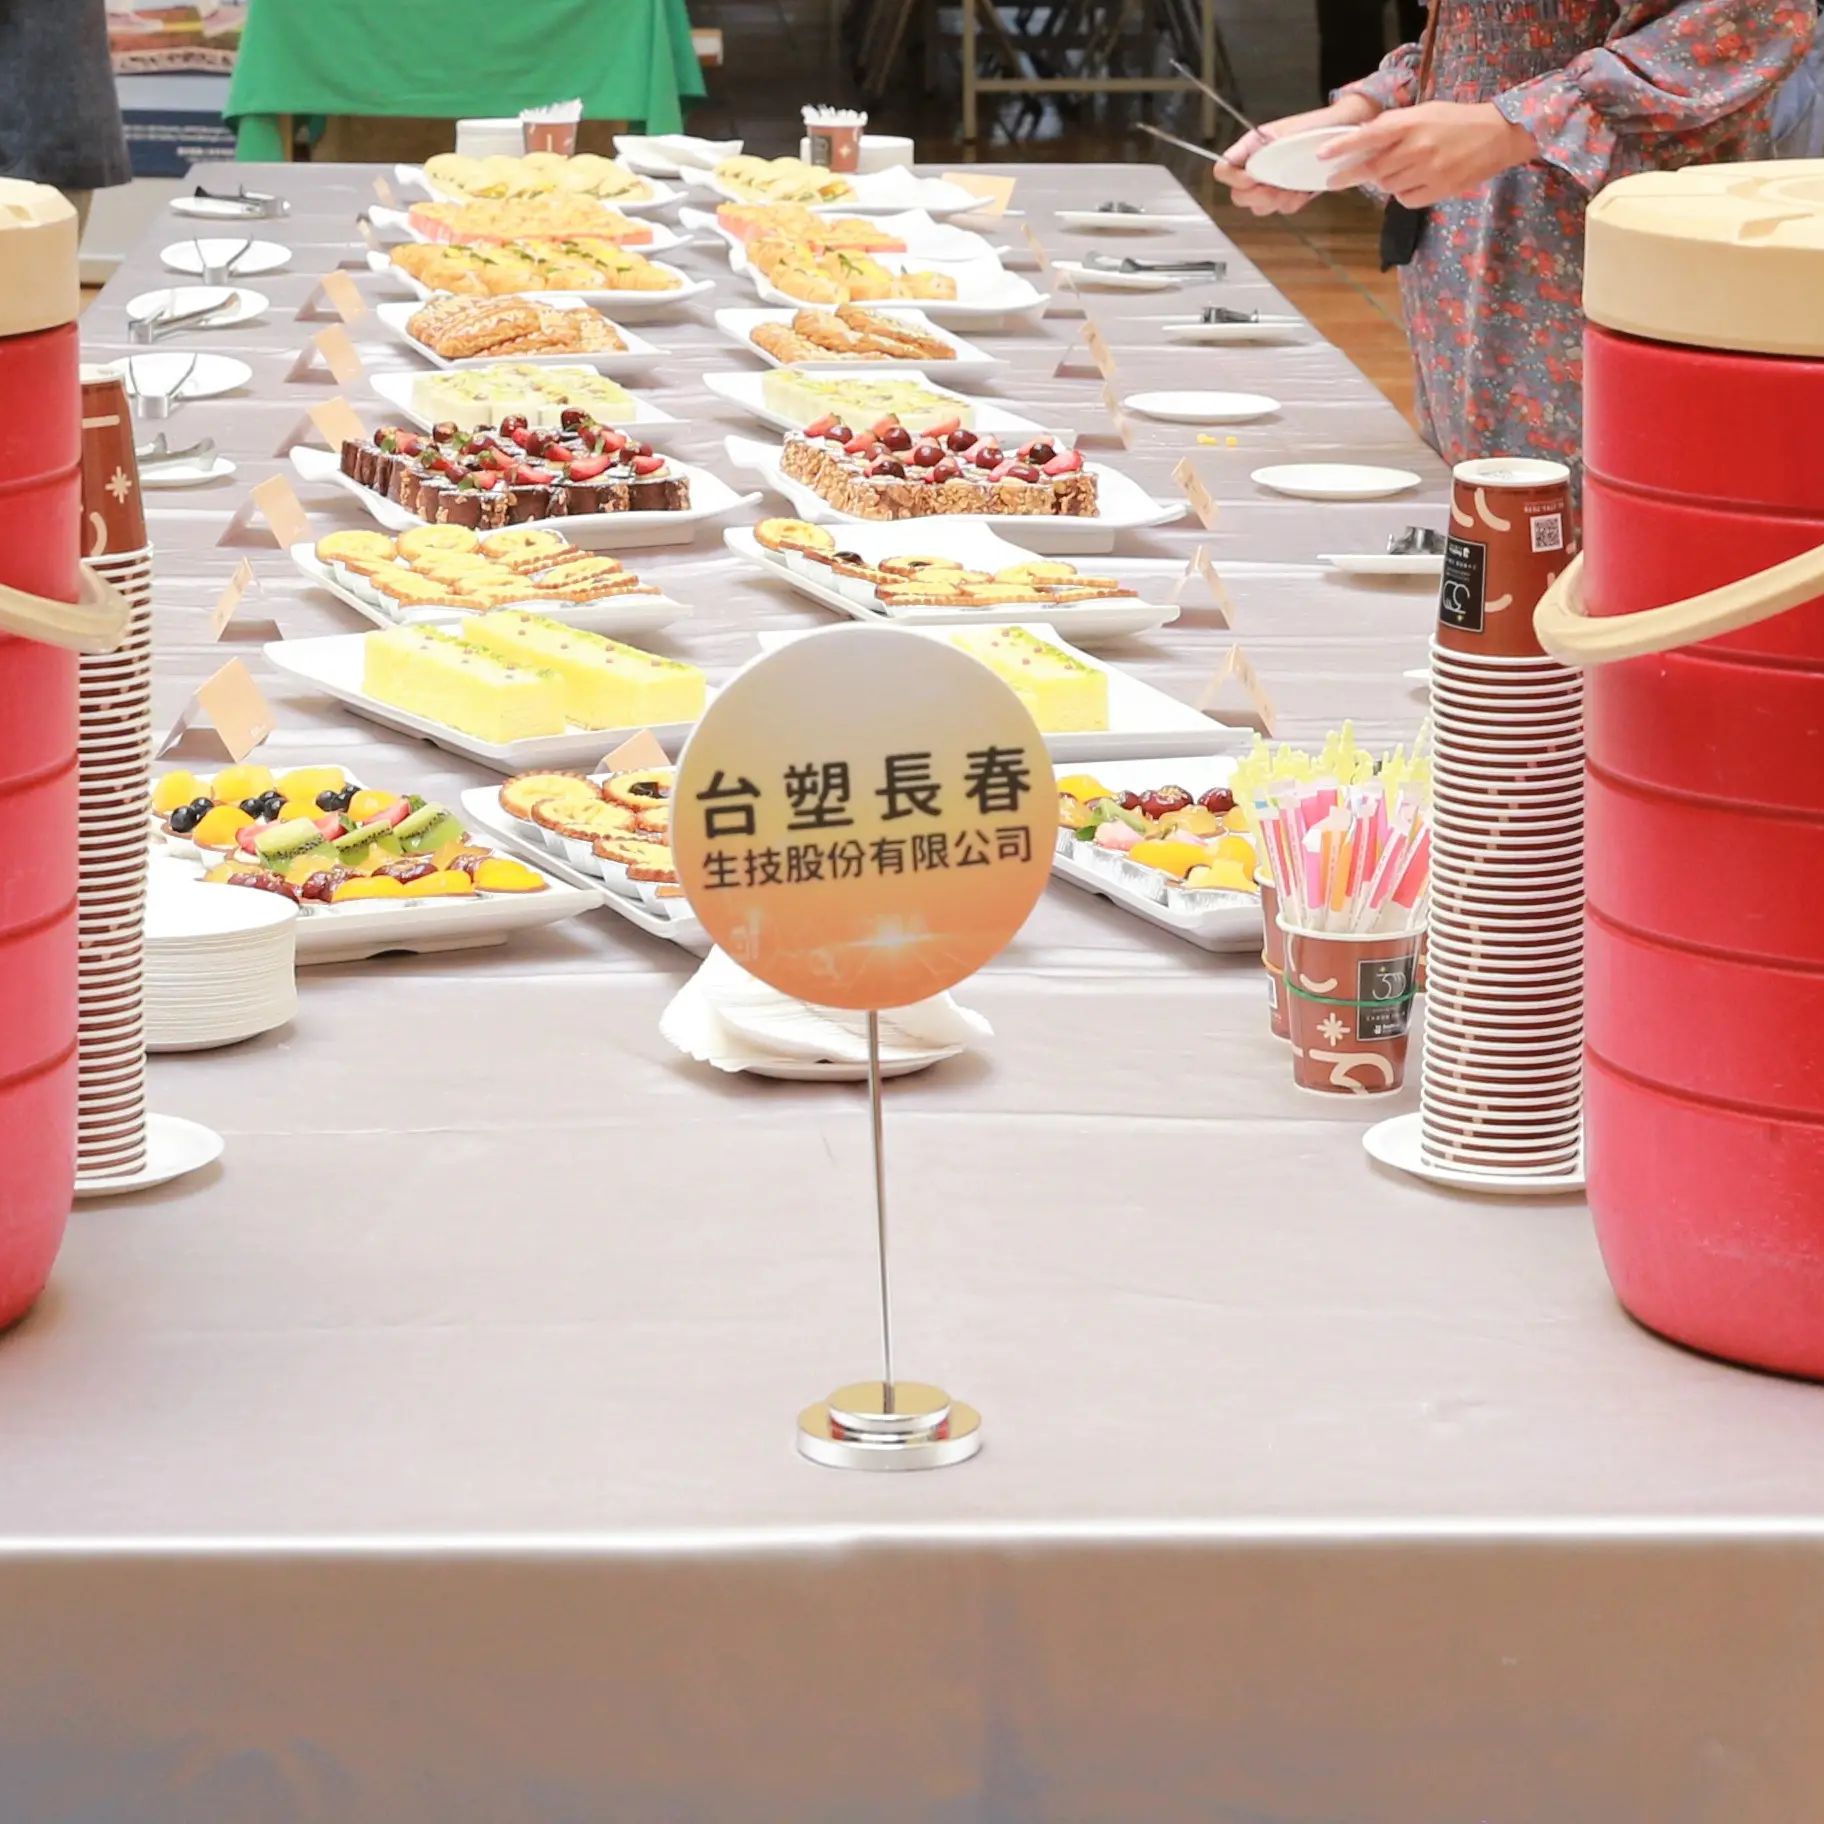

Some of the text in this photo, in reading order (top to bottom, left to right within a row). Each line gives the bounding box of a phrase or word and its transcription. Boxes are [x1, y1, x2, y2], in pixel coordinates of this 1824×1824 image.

[696, 746, 1032, 839] 台塑長春
[702, 825, 1033, 890] 生技股份有限公司
